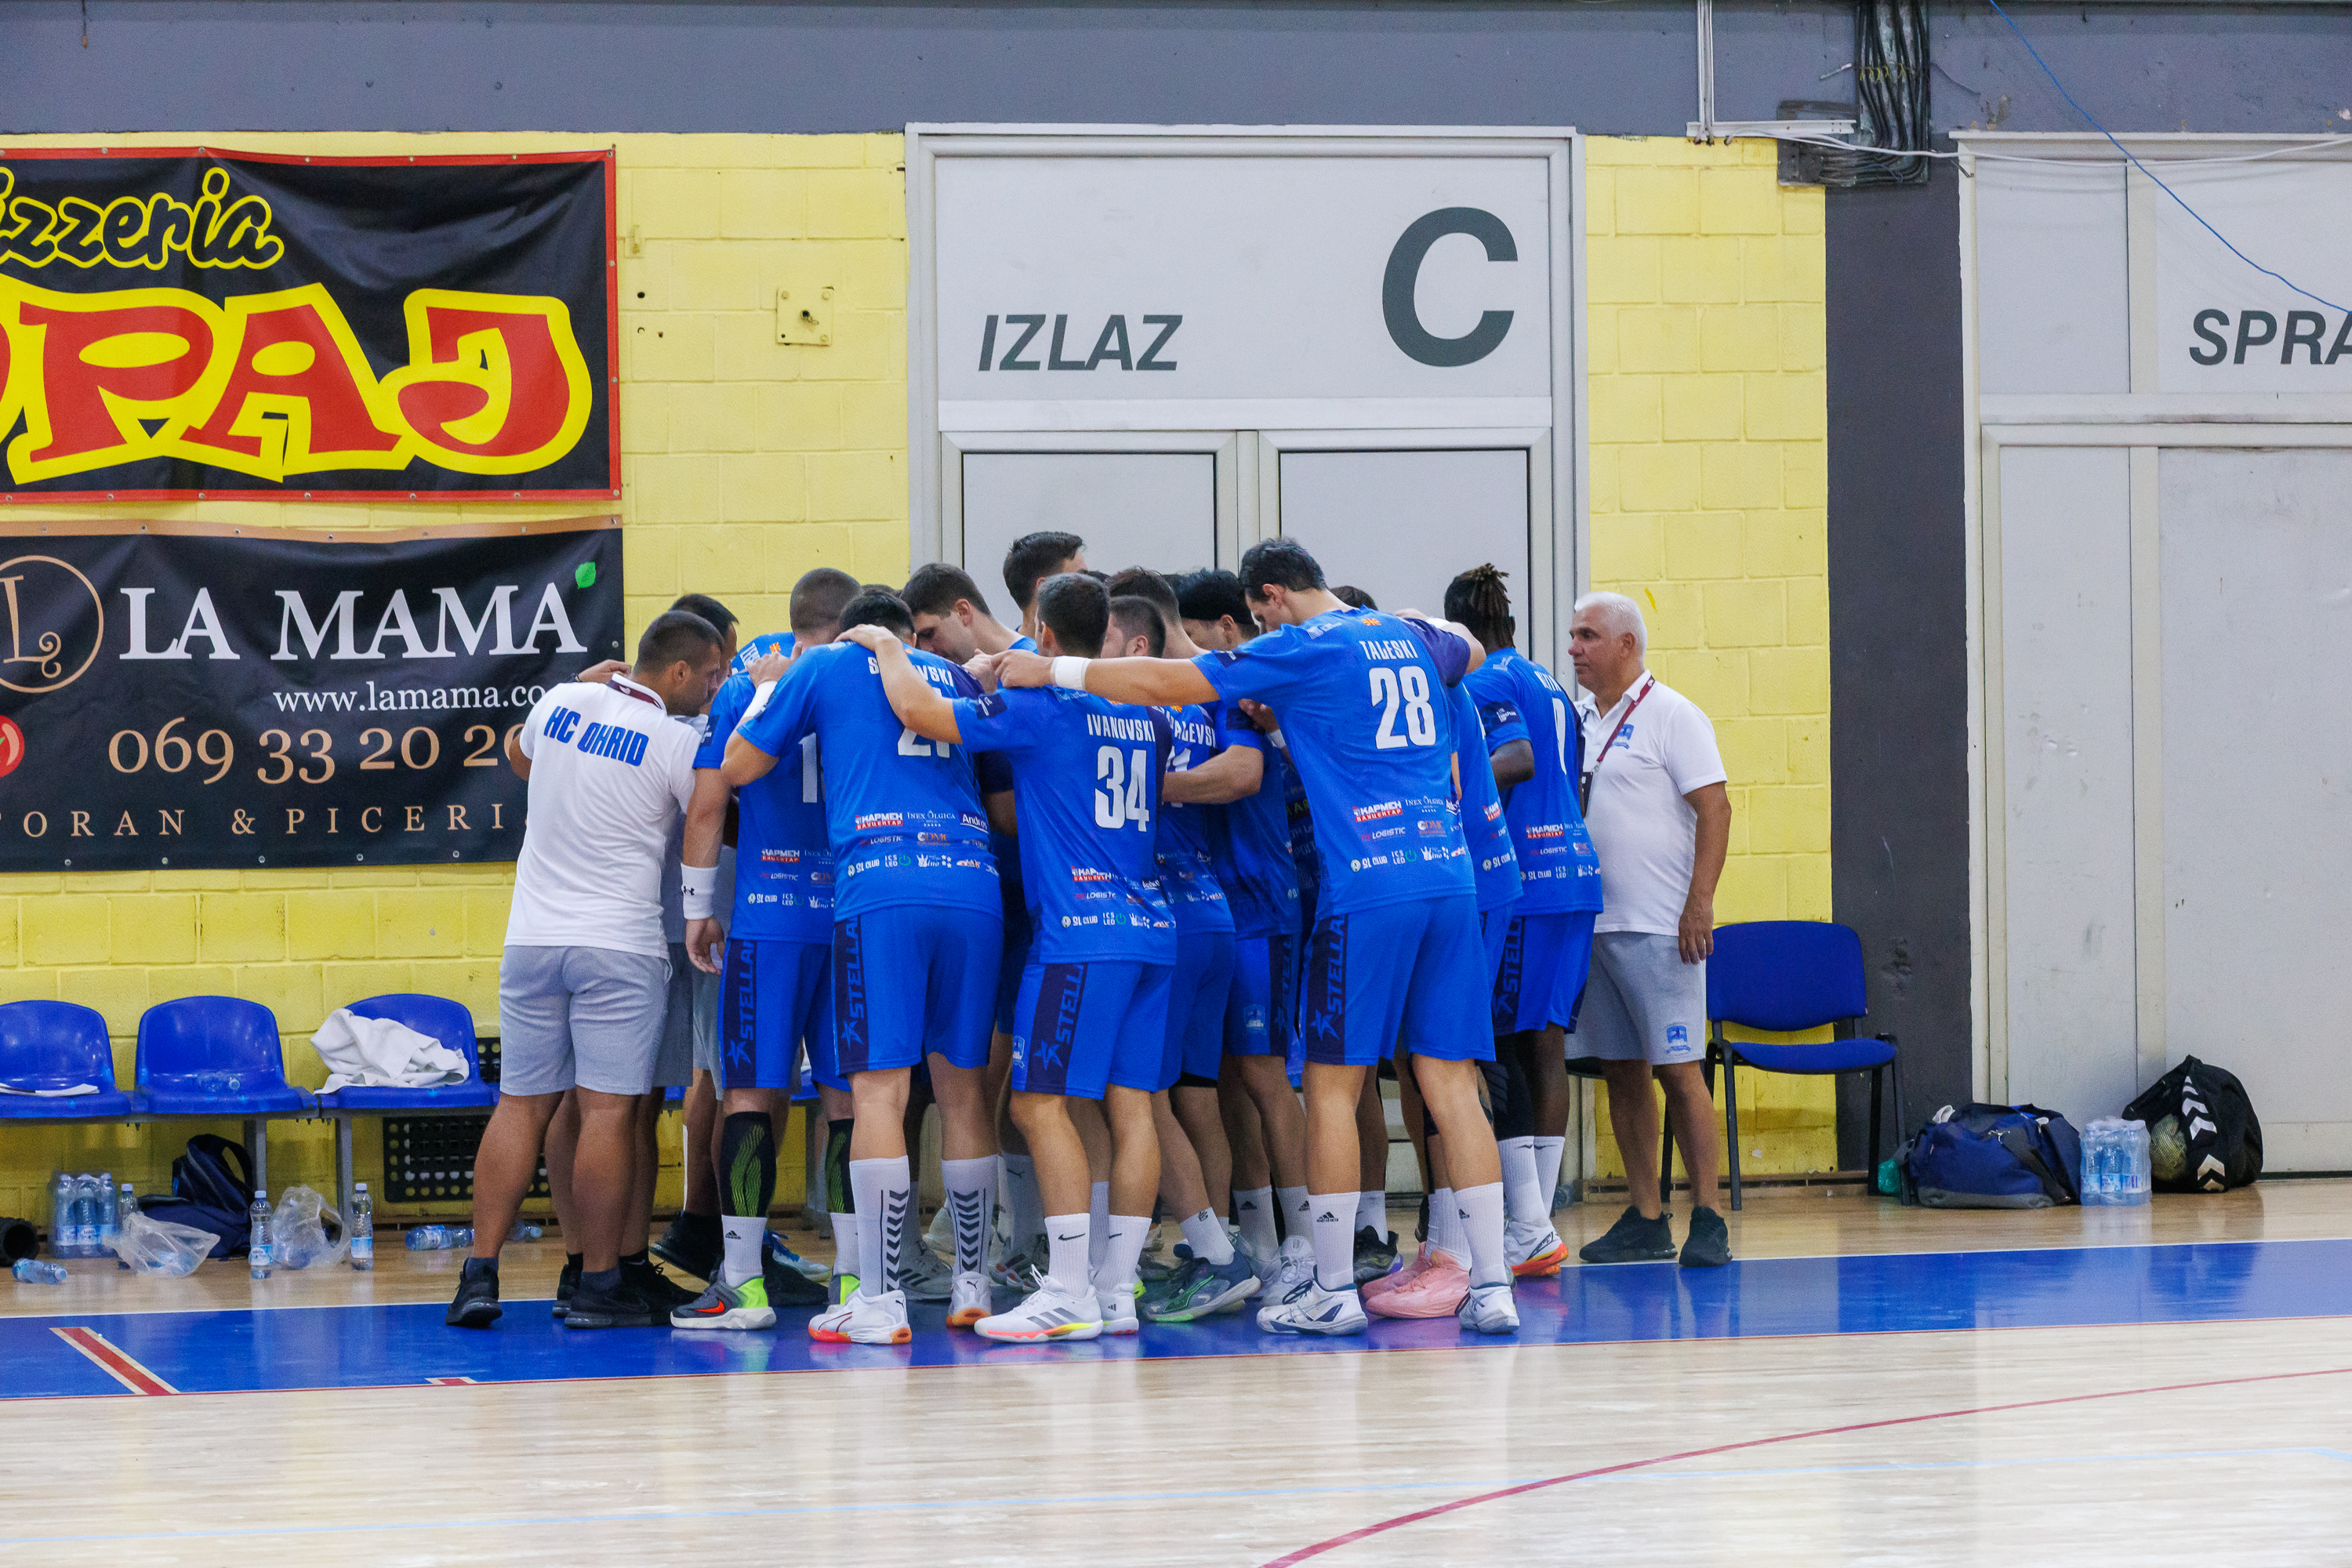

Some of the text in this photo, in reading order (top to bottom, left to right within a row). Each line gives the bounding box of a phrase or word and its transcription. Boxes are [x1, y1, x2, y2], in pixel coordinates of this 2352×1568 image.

[1381, 206, 1518, 368] C
[978, 314, 1183, 371] IZLAZ
[0, 274, 593, 485] PAJ
[119, 583, 588, 660] LA MAMA
[1359, 640, 1418, 660] TALESKI
[1087, 713, 1156, 742] IVANOVSKI
[1369, 666, 1436, 750] 28
[108, 717, 234, 785] 069
[257, 728, 335, 784] 33
[359, 727, 440, 771] 20
[544, 706, 649, 767] HC OHRID
[1094, 745, 1149, 832] 34
[0, 803, 528, 838] ORAN & PICERI
[870, 834, 903, 845] LOGISTIC
[1373, 827, 1406, 840] LOGISTIC
[866, 858, 880, 869] CLUB
[1540, 847, 1567, 855] LOGISTIC
[1083, 916, 1098, 924] CLUB
